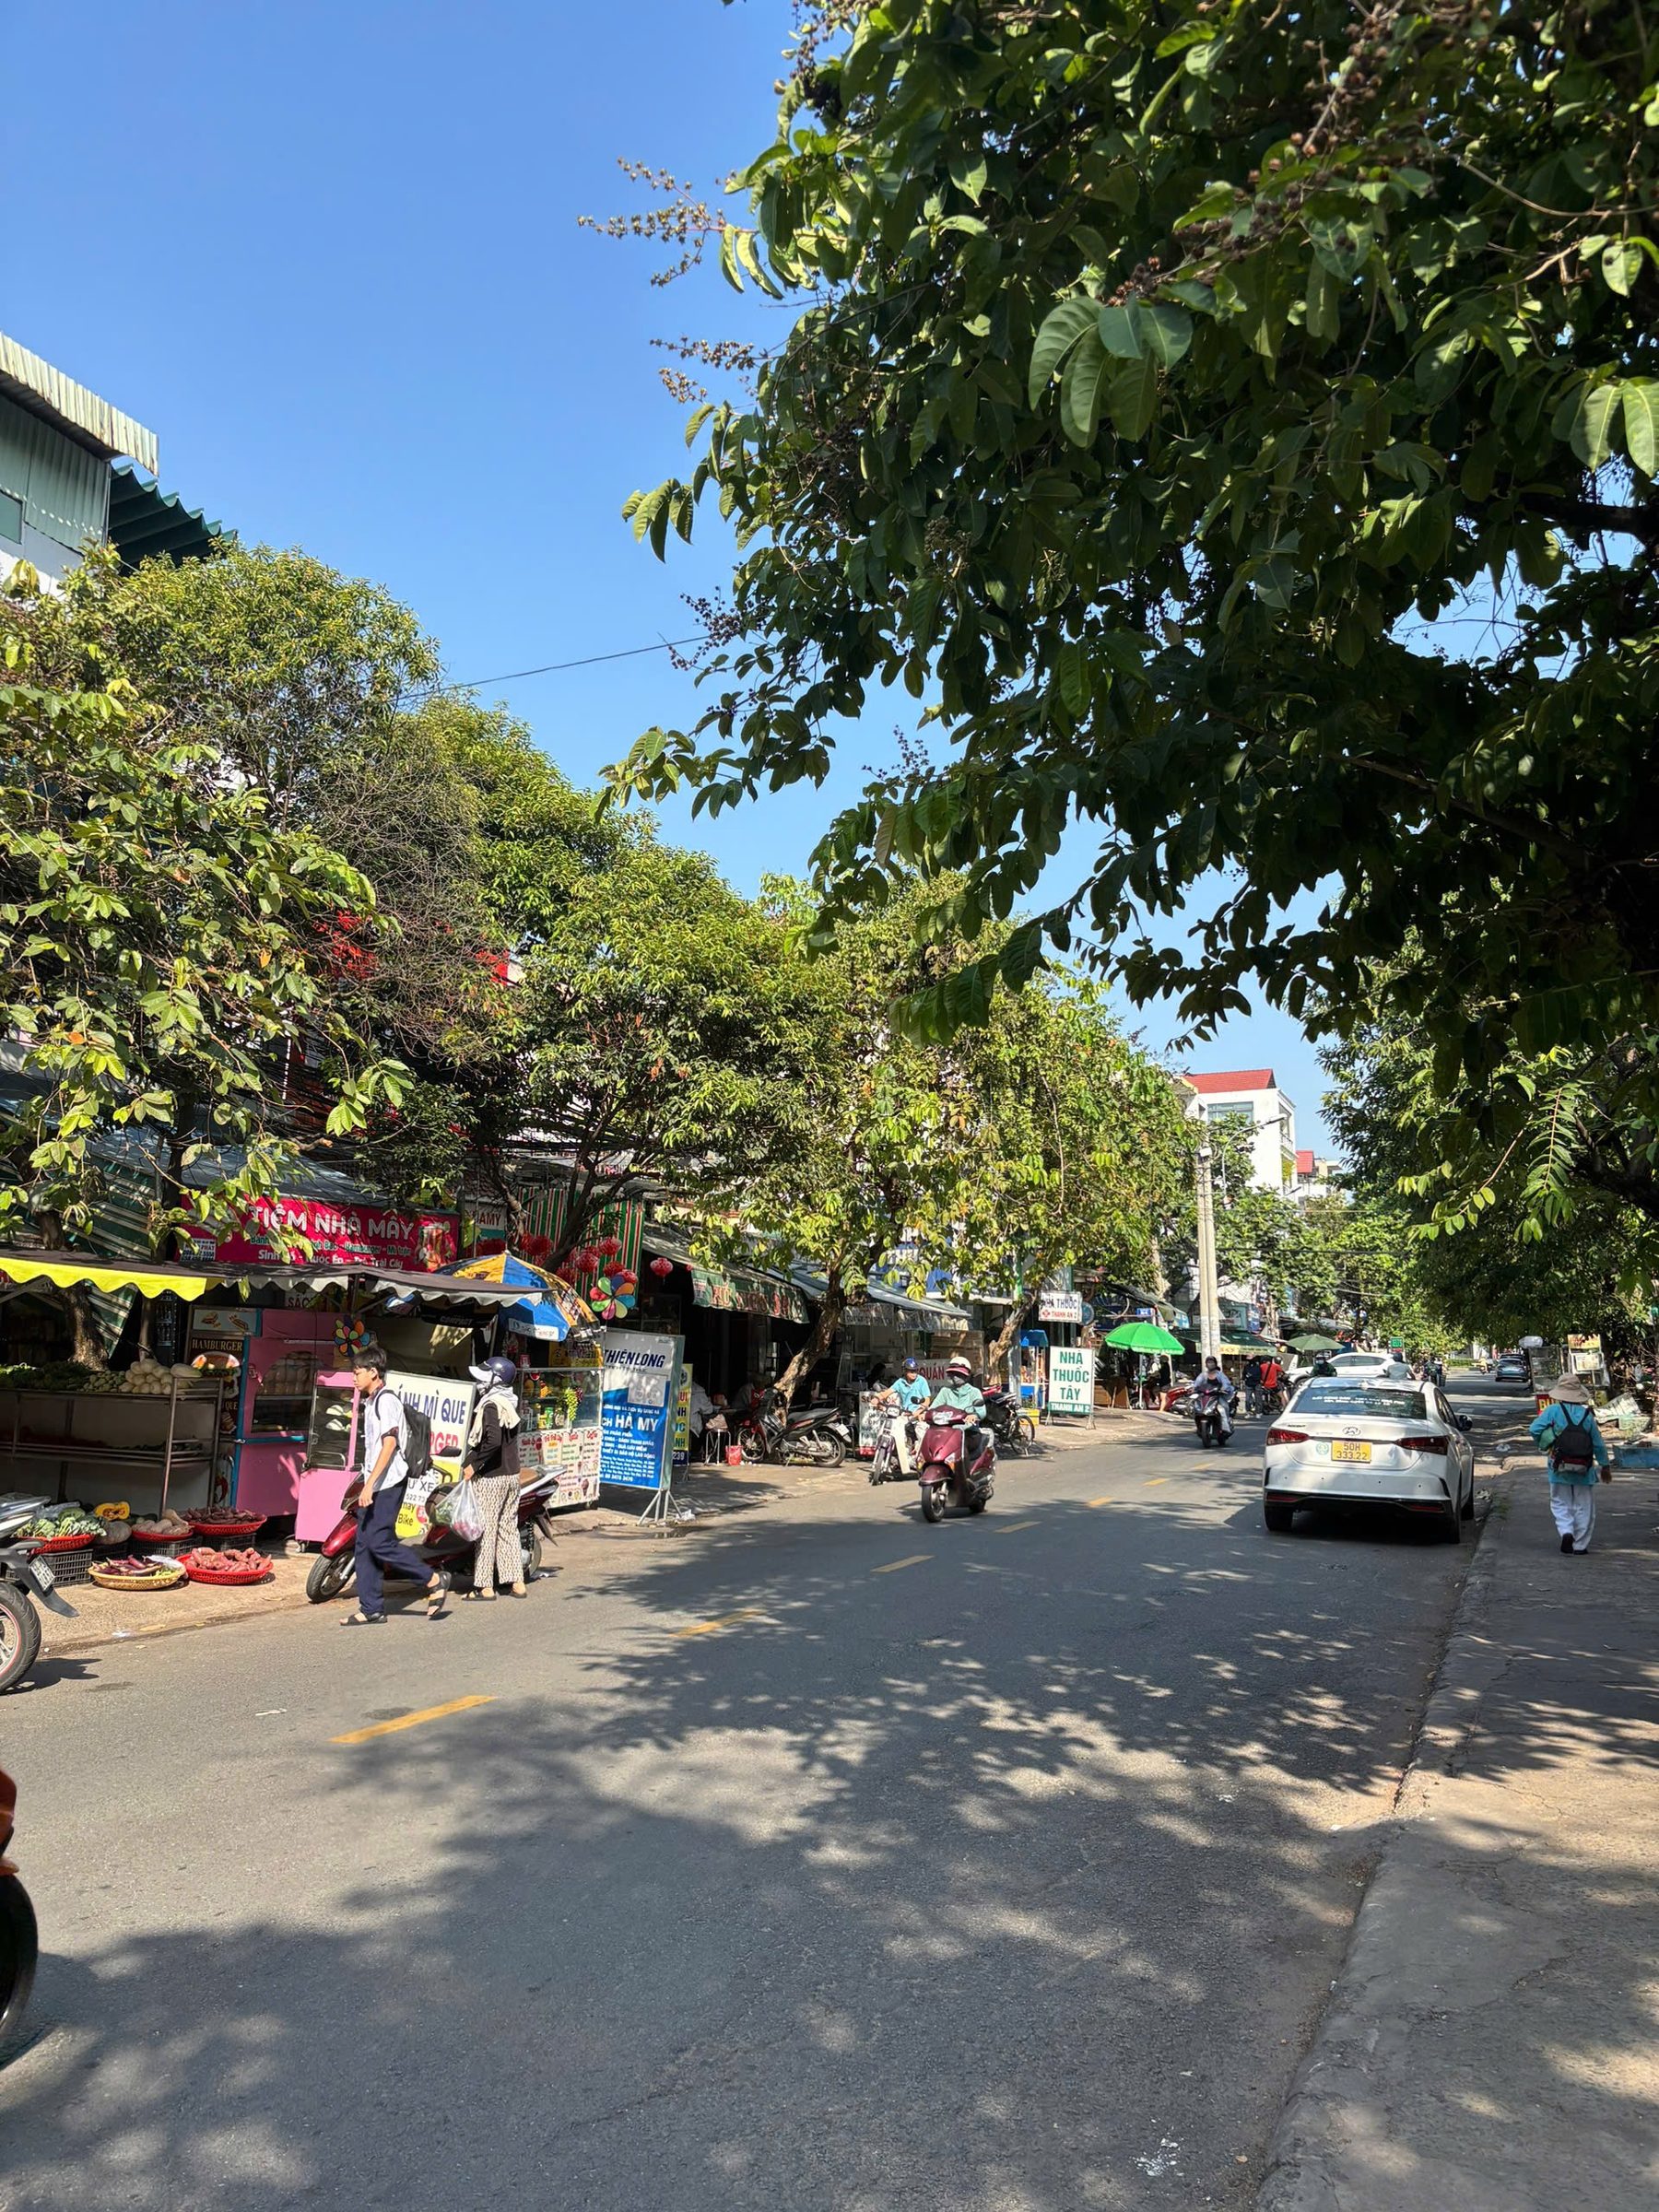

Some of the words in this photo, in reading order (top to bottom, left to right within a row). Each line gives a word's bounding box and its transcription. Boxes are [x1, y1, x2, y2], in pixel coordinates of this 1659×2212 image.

[314, 1210, 361, 1237] NHÀ
[369, 1216, 415, 1240] MÂY
[192, 1338, 242, 1351] HAMBURGER
[1059, 1349, 1083, 1364] NHÀ
[1053, 1366, 1089, 1382] THUỐC
[1060, 1384, 1080, 1401] TÂY
[397, 1384, 421, 1412] ÁNH
[441, 1398, 466, 1424] QUE
[615, 1412, 634, 1429] HÀ
[637, 1416, 659, 1431] MY
[1343, 1442, 1361, 1451] 50H
[1335, 1450, 1368, 1460] 333.22
[419, 1480, 434, 1492] XE
[397, 1513, 414, 1526] Bike
